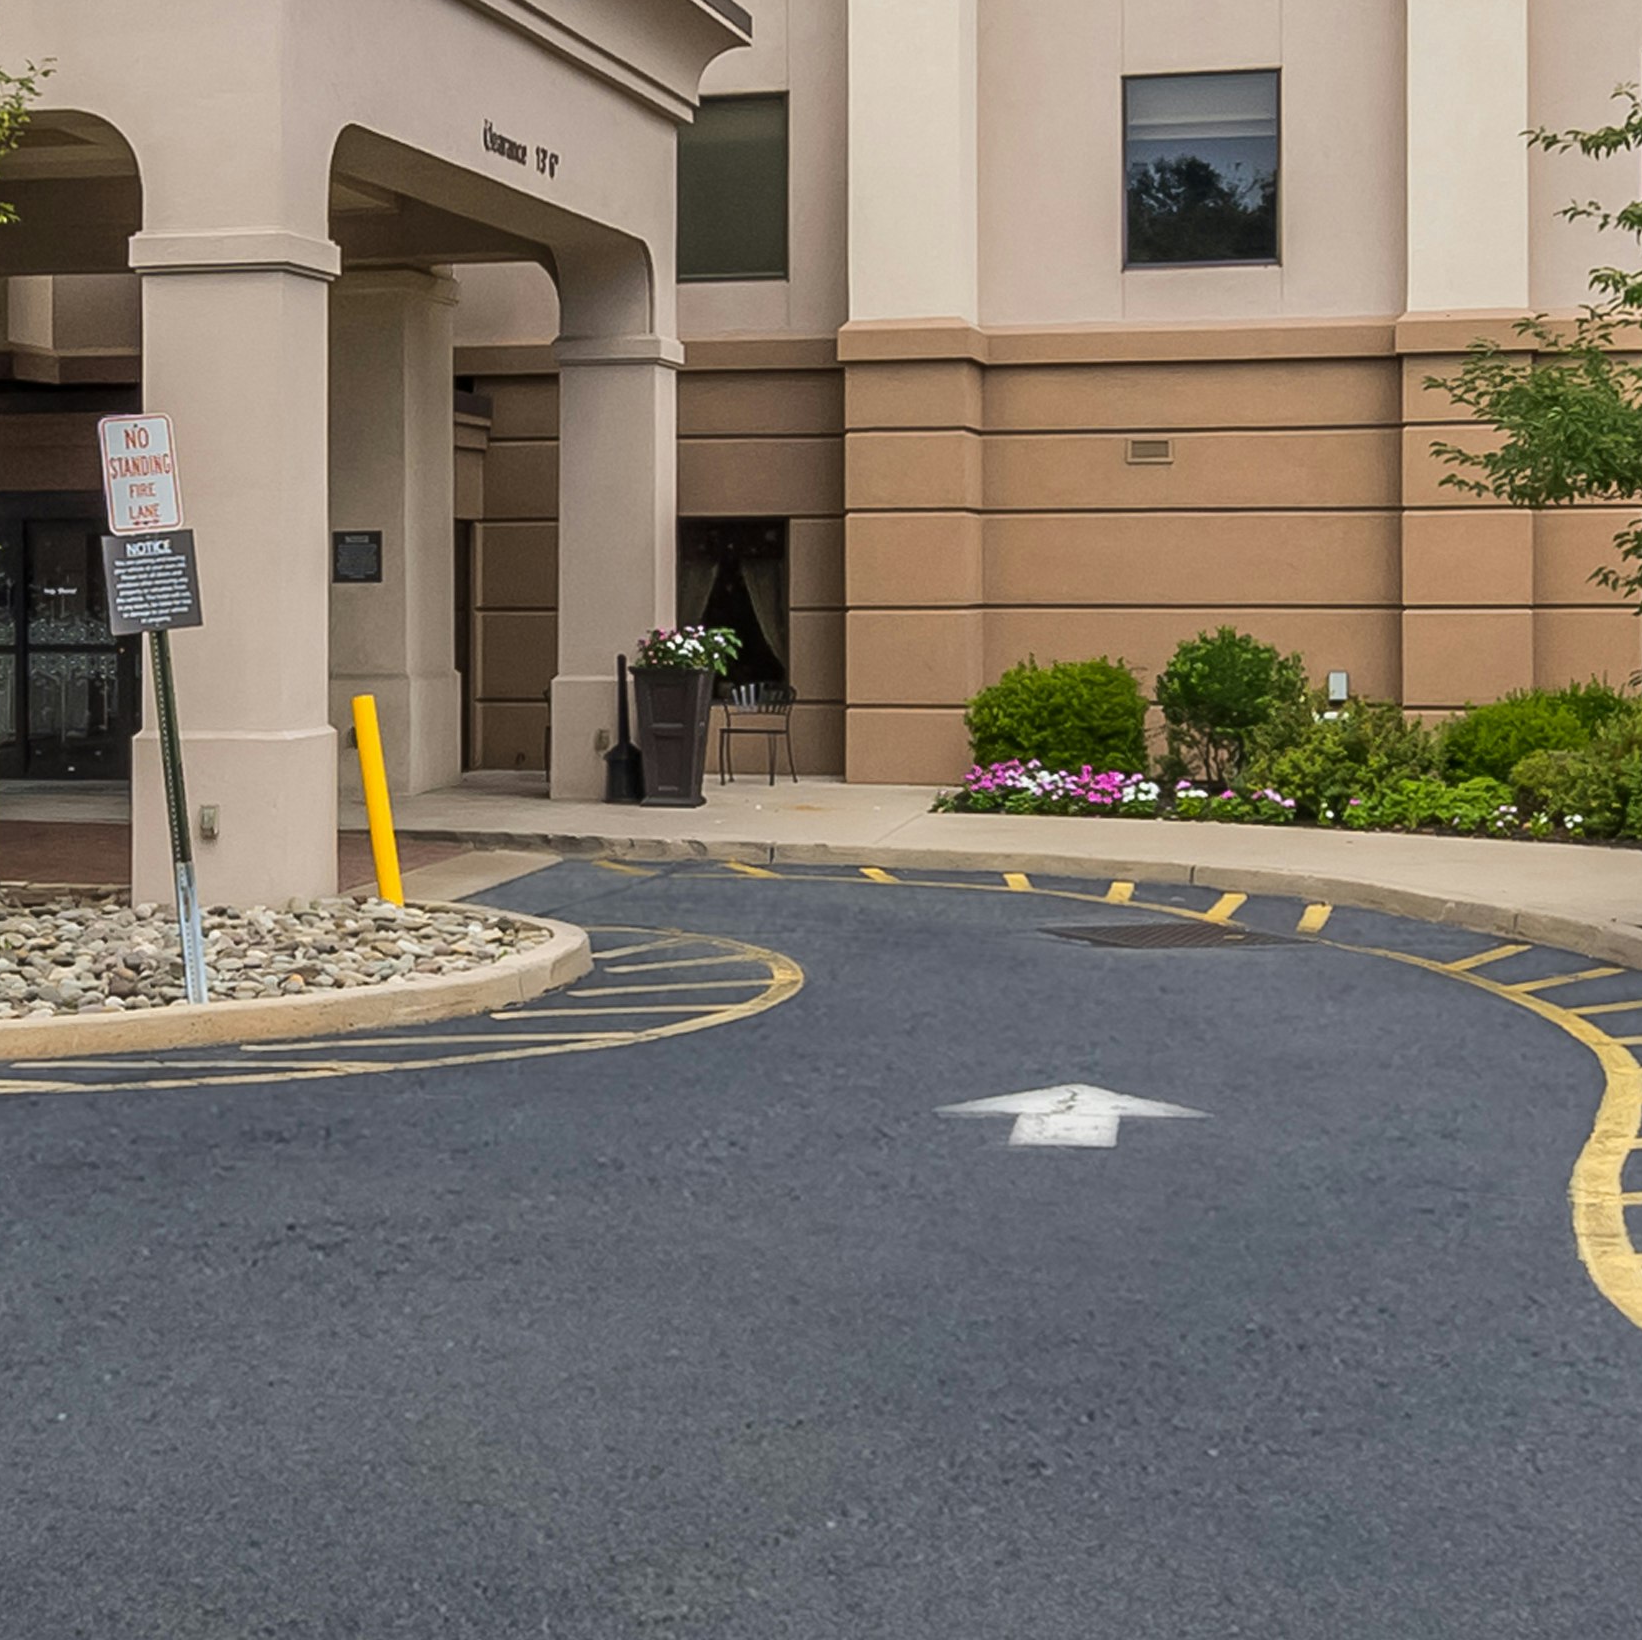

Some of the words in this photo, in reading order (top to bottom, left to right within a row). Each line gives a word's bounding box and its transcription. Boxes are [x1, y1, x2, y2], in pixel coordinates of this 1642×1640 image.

[124, 427, 149, 449] NO
[110, 454, 171, 479] STANDING
[129, 482, 157, 499] FIRE
[128, 503, 161, 520] LANE
[126, 539, 172, 557] NOTICE
